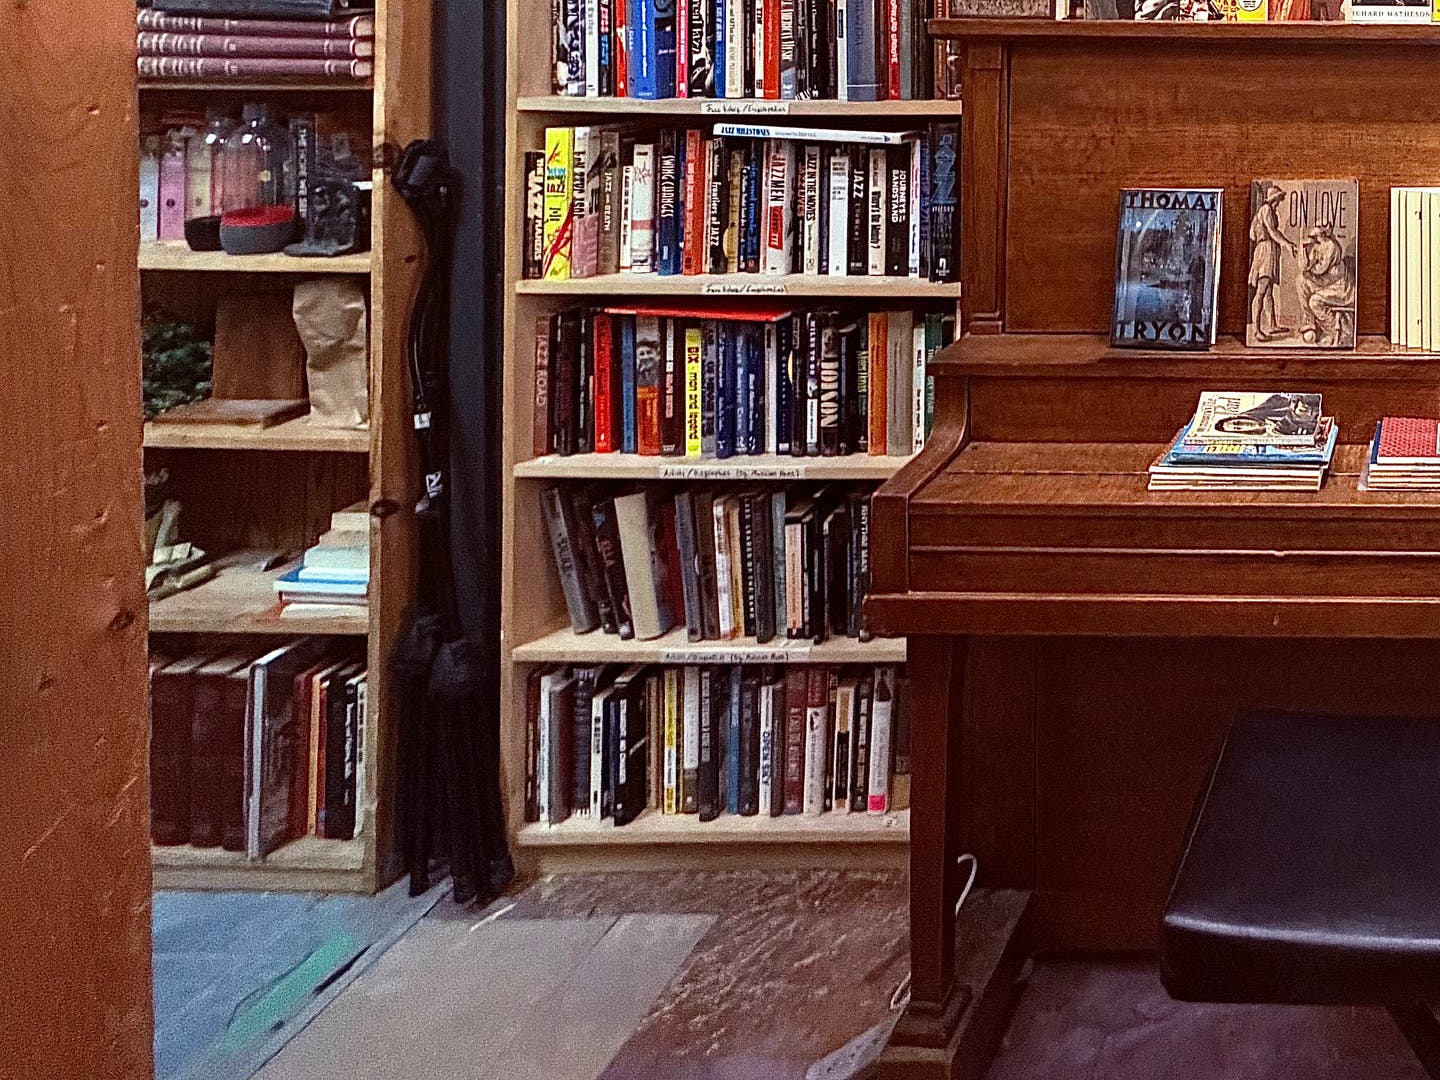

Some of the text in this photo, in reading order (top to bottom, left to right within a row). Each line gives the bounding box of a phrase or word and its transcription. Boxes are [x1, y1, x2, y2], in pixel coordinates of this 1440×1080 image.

[769, 155, 784, 202] JAZZMEN
[853, 168, 864, 198] JAZZ
[1126, 192, 1217, 210] THOMAS
[1289, 190, 1347, 229] ON LOVE
[1116, 321, 1209, 342] TRYON
